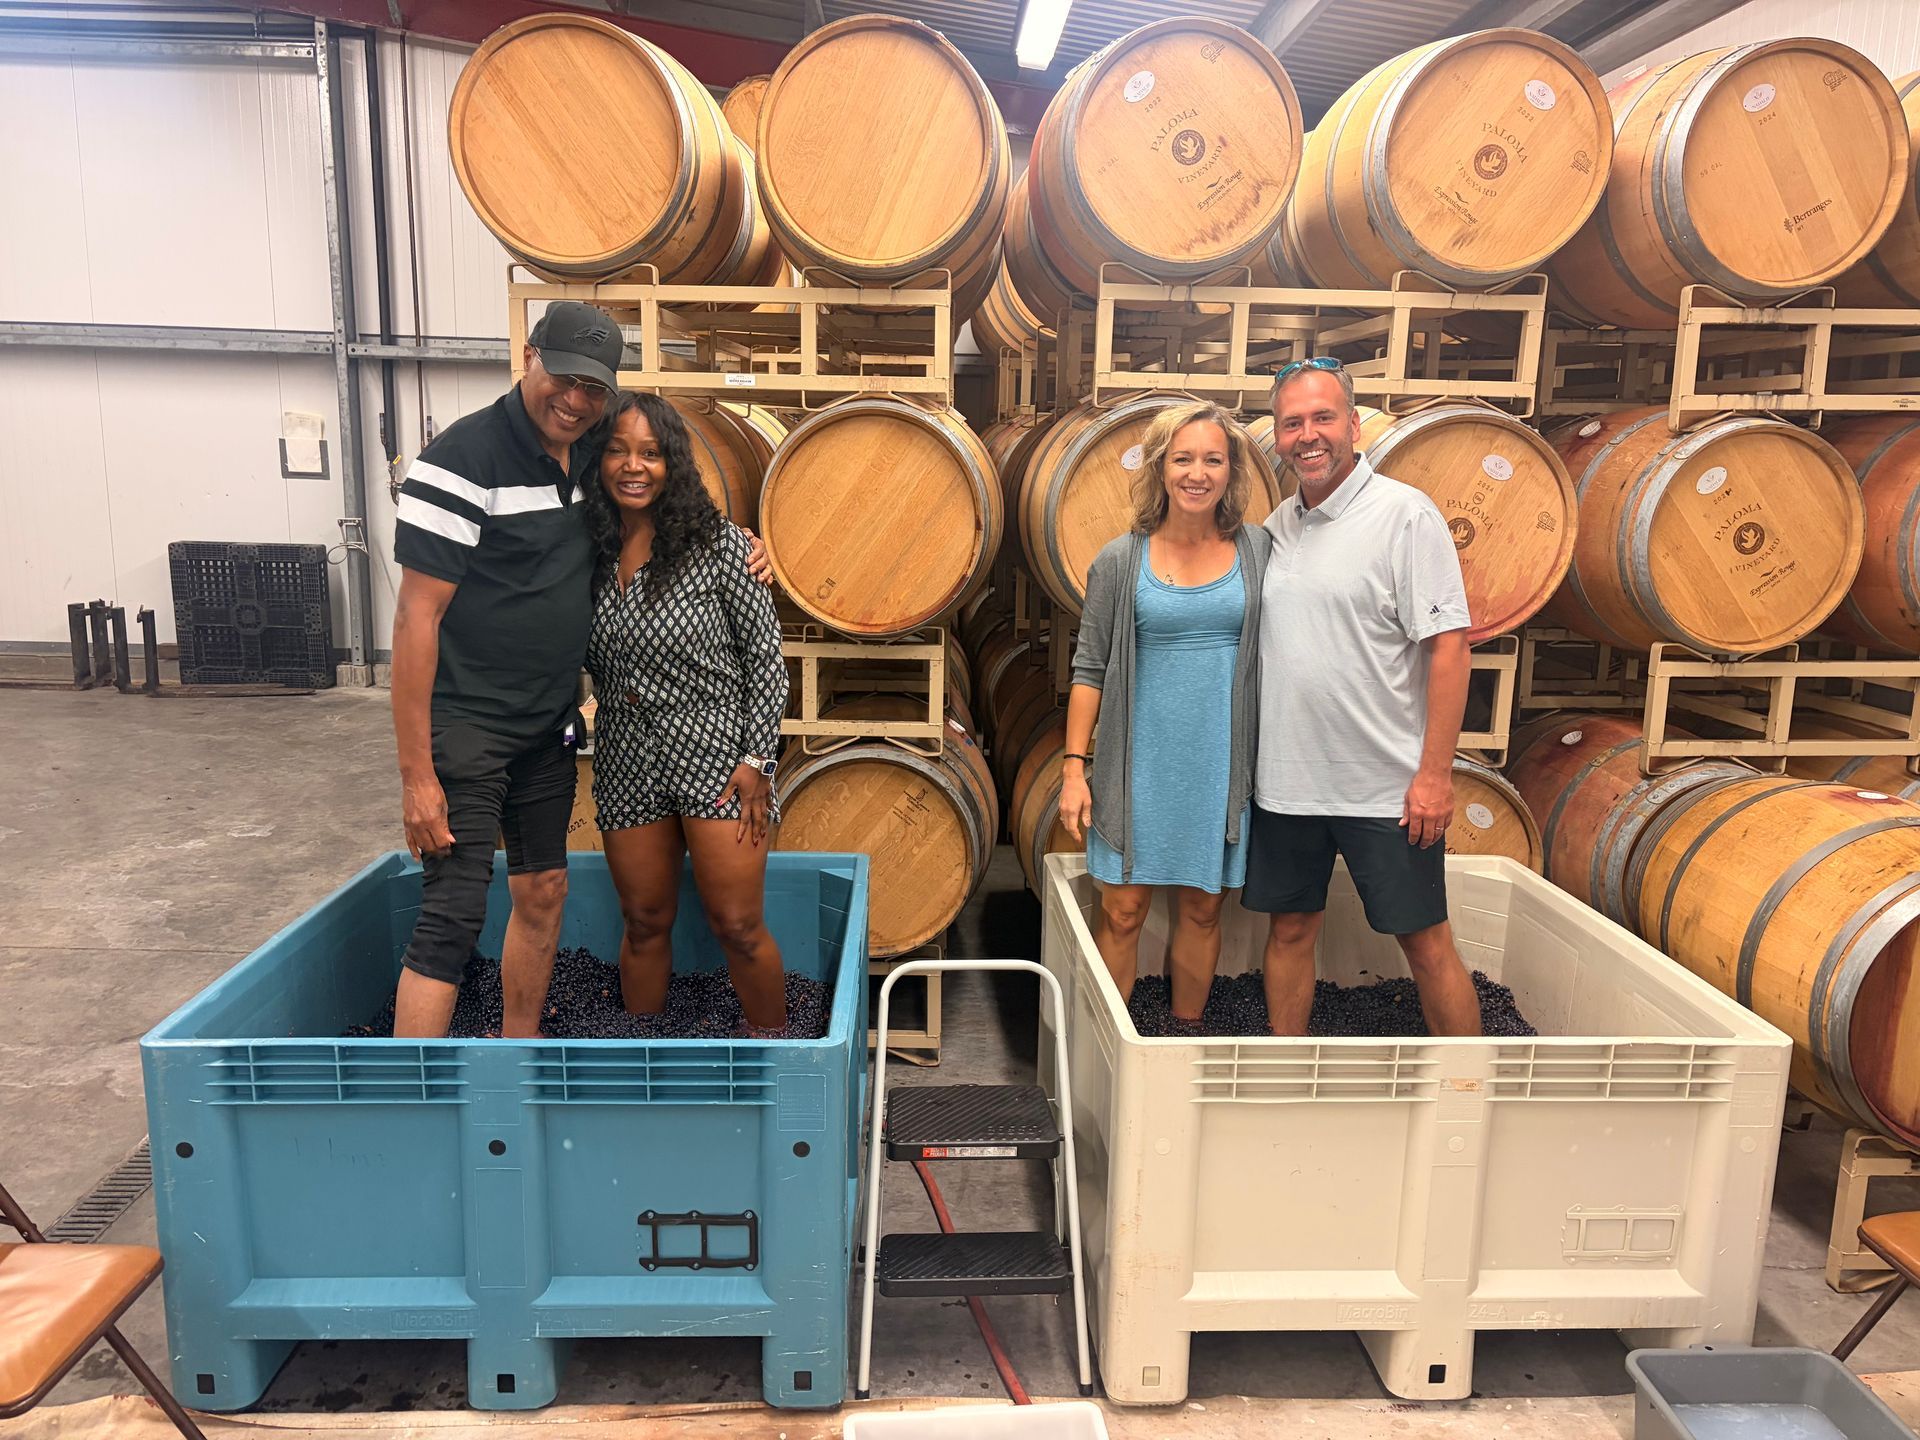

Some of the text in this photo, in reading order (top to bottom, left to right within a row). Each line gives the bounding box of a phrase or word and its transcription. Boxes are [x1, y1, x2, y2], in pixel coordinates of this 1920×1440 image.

[1144, 96, 1162, 113] 2022
[1758, 111, 1777, 126] 2024
[1151, 108, 1199, 152] PALOMA
[1482, 122, 1528, 164] PALOMA
[1177, 145, 1223, 184] VINEYARD
[1456, 159, 1498, 198] VINEYARD
[1197, 184, 1226, 210] Expression
[1224, 169, 1243, 186] Rouge
[1433, 185, 1462, 211] Expression
[1793, 198, 1833, 224] Bertranges
[1477, 480, 1495, 493] 2024
[1446, 499, 1494, 531] PALOMA
[1714, 501, 1763, 542] PALOMA
[1734, 537, 1781, 573] VINEYARD
[1749, 574, 1779, 597] Expression
[1777, 560, 1797, 576] Rouge
[395, 1311, 470, 1329] MacroBin
[1338, 1304, 1410, 1321] MacroBin
